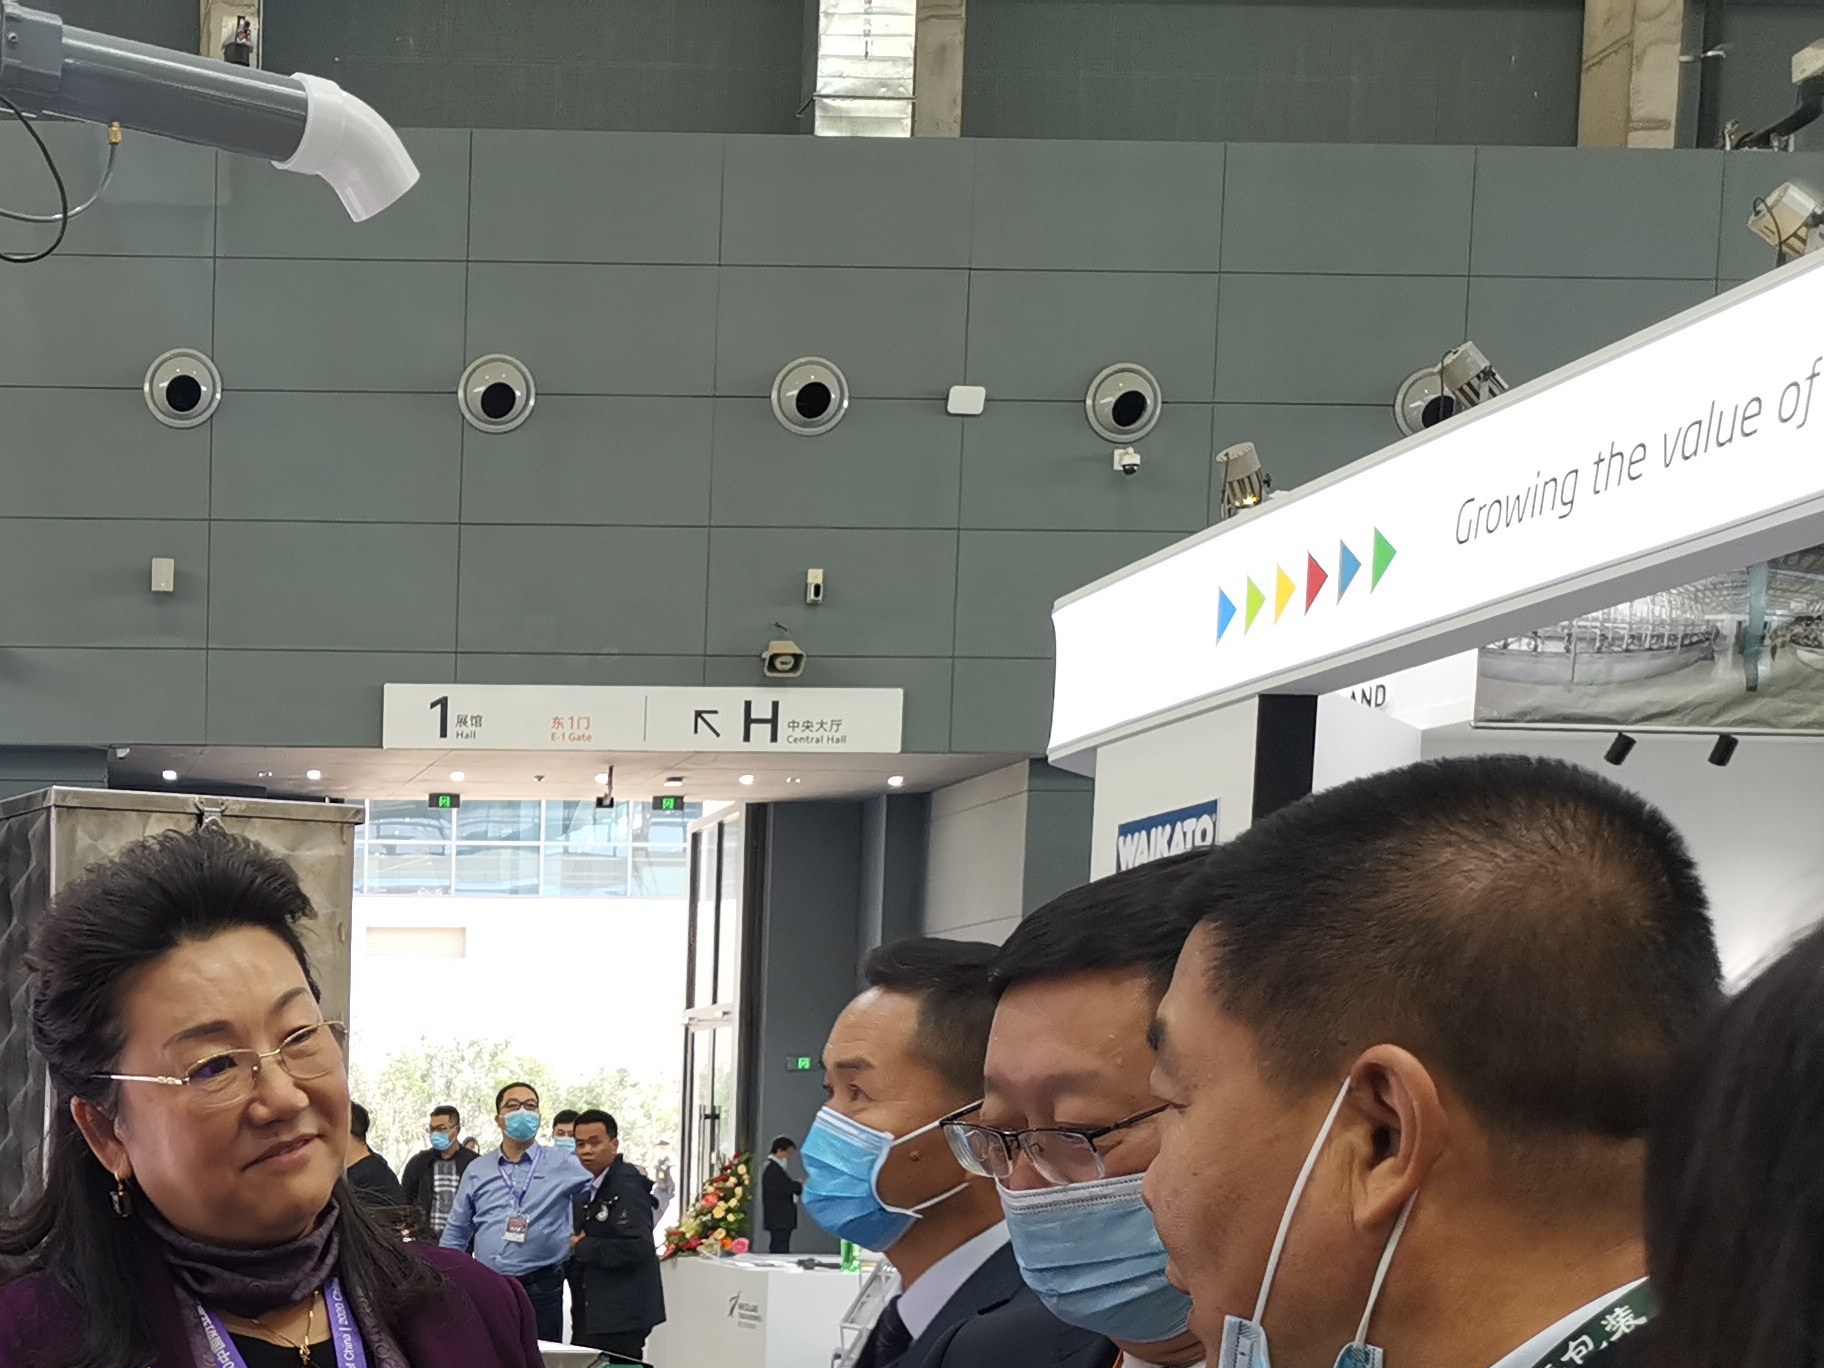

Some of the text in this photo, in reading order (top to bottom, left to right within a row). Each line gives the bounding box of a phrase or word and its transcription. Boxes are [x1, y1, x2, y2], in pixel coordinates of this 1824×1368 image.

[1455, 356, 1824, 546] Growing the value of
[428, 695, 448, 739] 1
[455, 713, 483, 729] 展馆
[550, 715, 591, 731] 东1门
[742, 700, 780, 743] H
[786, 718, 844, 734] 中央大厅
[455, 730, 477, 740] Hall
[550, 732, 593, 744] E-1 Gate
[786, 734, 848, 745] Central Hall
[1117, 814, 1215, 871] WAIKATO
[342, 1333, 354, 1360] China
